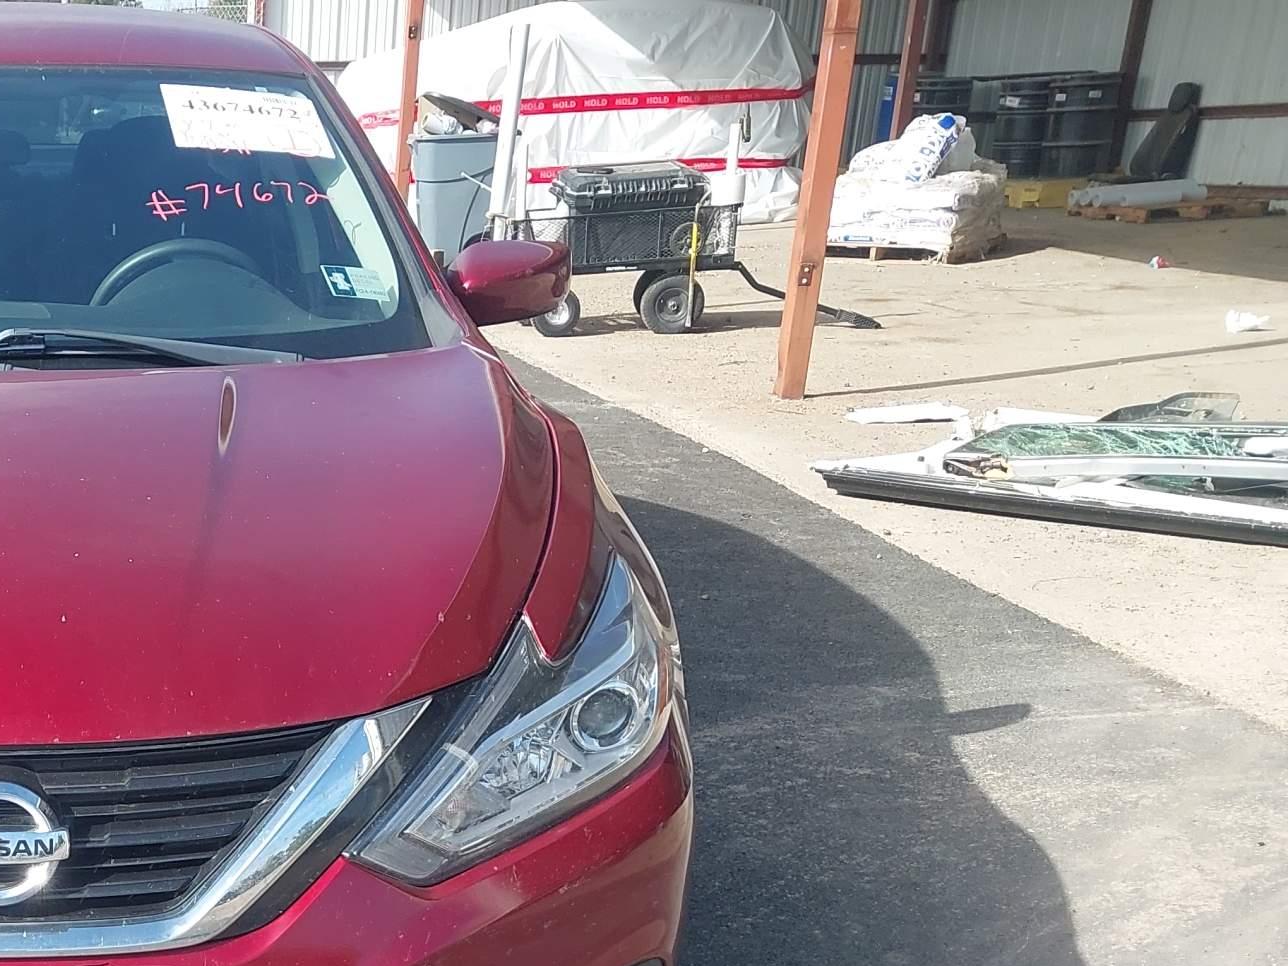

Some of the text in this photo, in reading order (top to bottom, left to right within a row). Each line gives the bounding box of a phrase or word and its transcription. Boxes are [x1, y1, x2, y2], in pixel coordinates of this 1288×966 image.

[182, 99, 300, 119] 43674672
[520, 102, 545, 111] HOLD
[552, 100, 577, 109] HOLD
[583, 98, 608, 107] HOLD
[615, 97, 639, 106] HOLD
[646, 95, 670, 104] HOLD
[677, 95, 701, 104] HOLD
[540, 171, 556, 179] HOL
[146, 180, 332, 222] #74672
